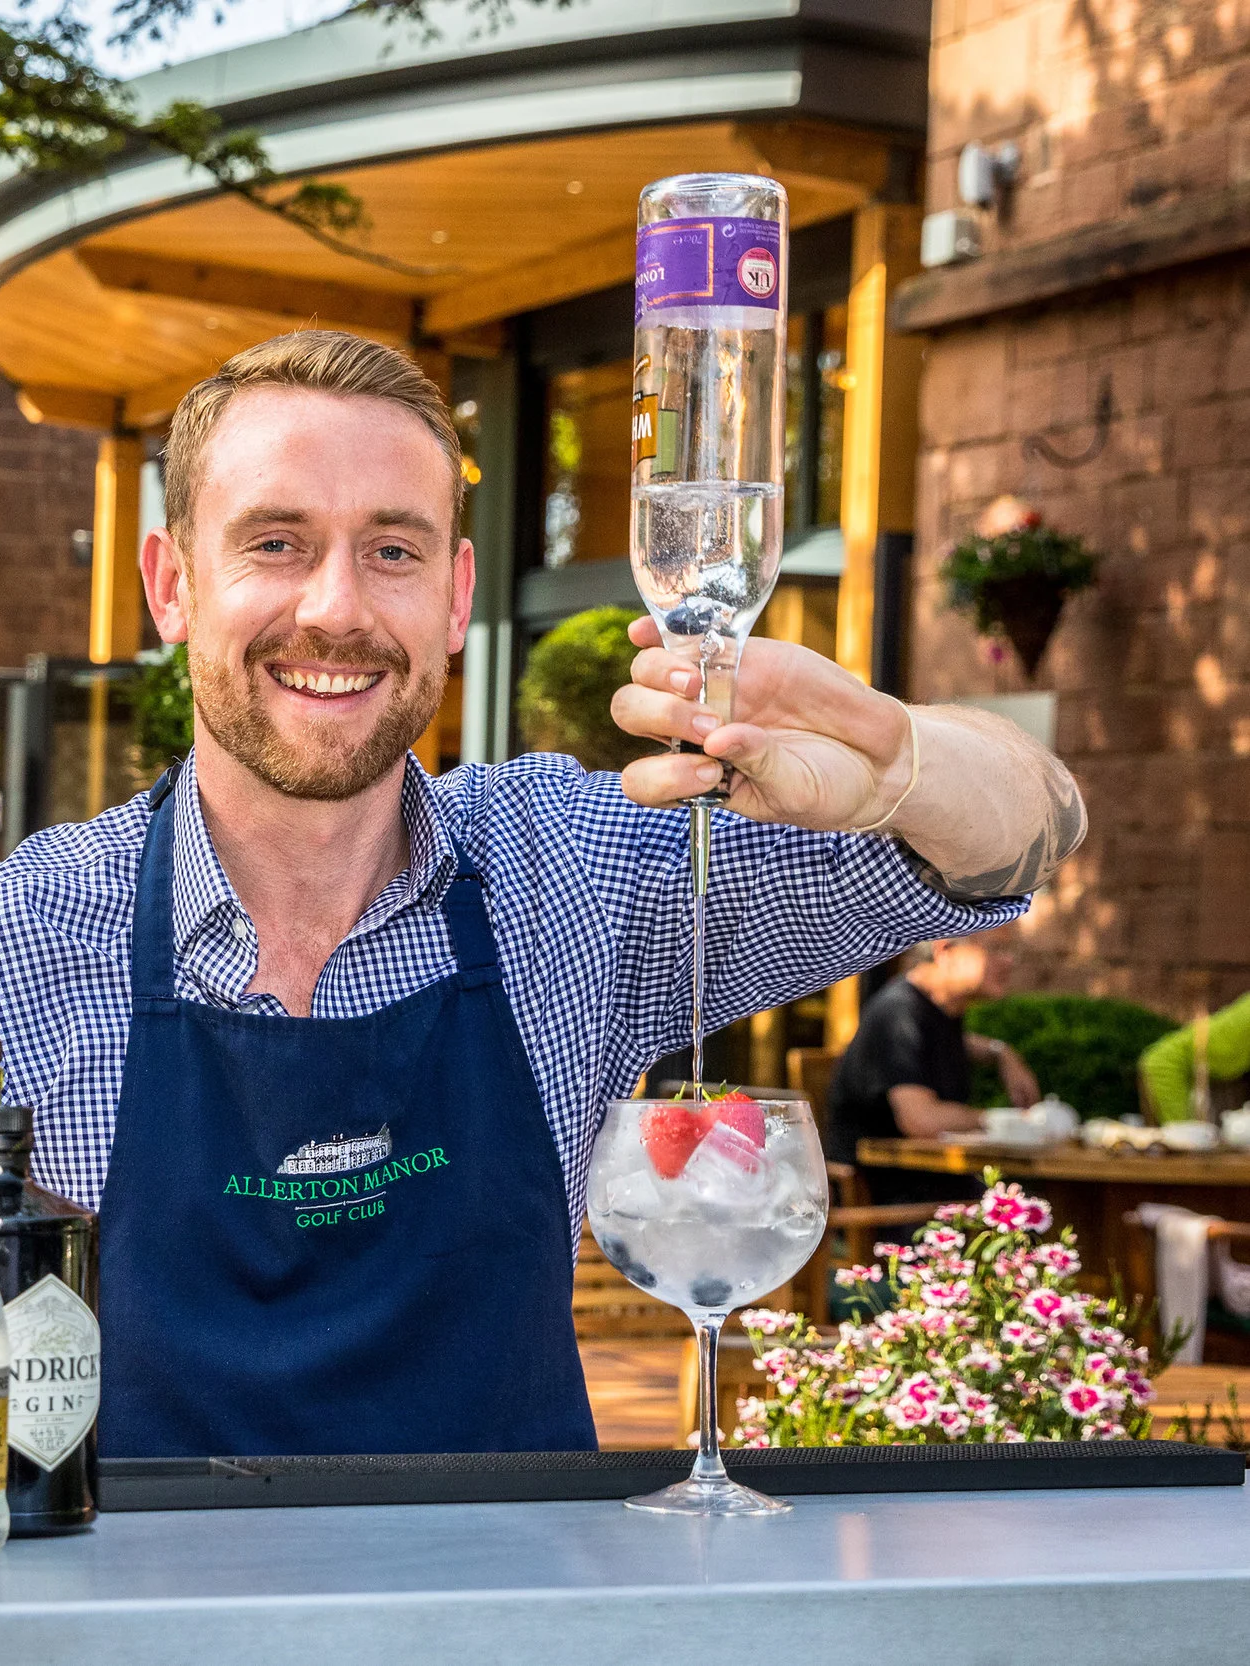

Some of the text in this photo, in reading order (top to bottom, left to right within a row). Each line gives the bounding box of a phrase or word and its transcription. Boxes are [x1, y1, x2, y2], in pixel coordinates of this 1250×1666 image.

[747, 271, 771, 288] UK
[223, 1147, 450, 1201] ALLERTON MANOR
[296, 1200, 385, 1228] GOLF CLUB
[25, 1394, 74, 1413] GIN
